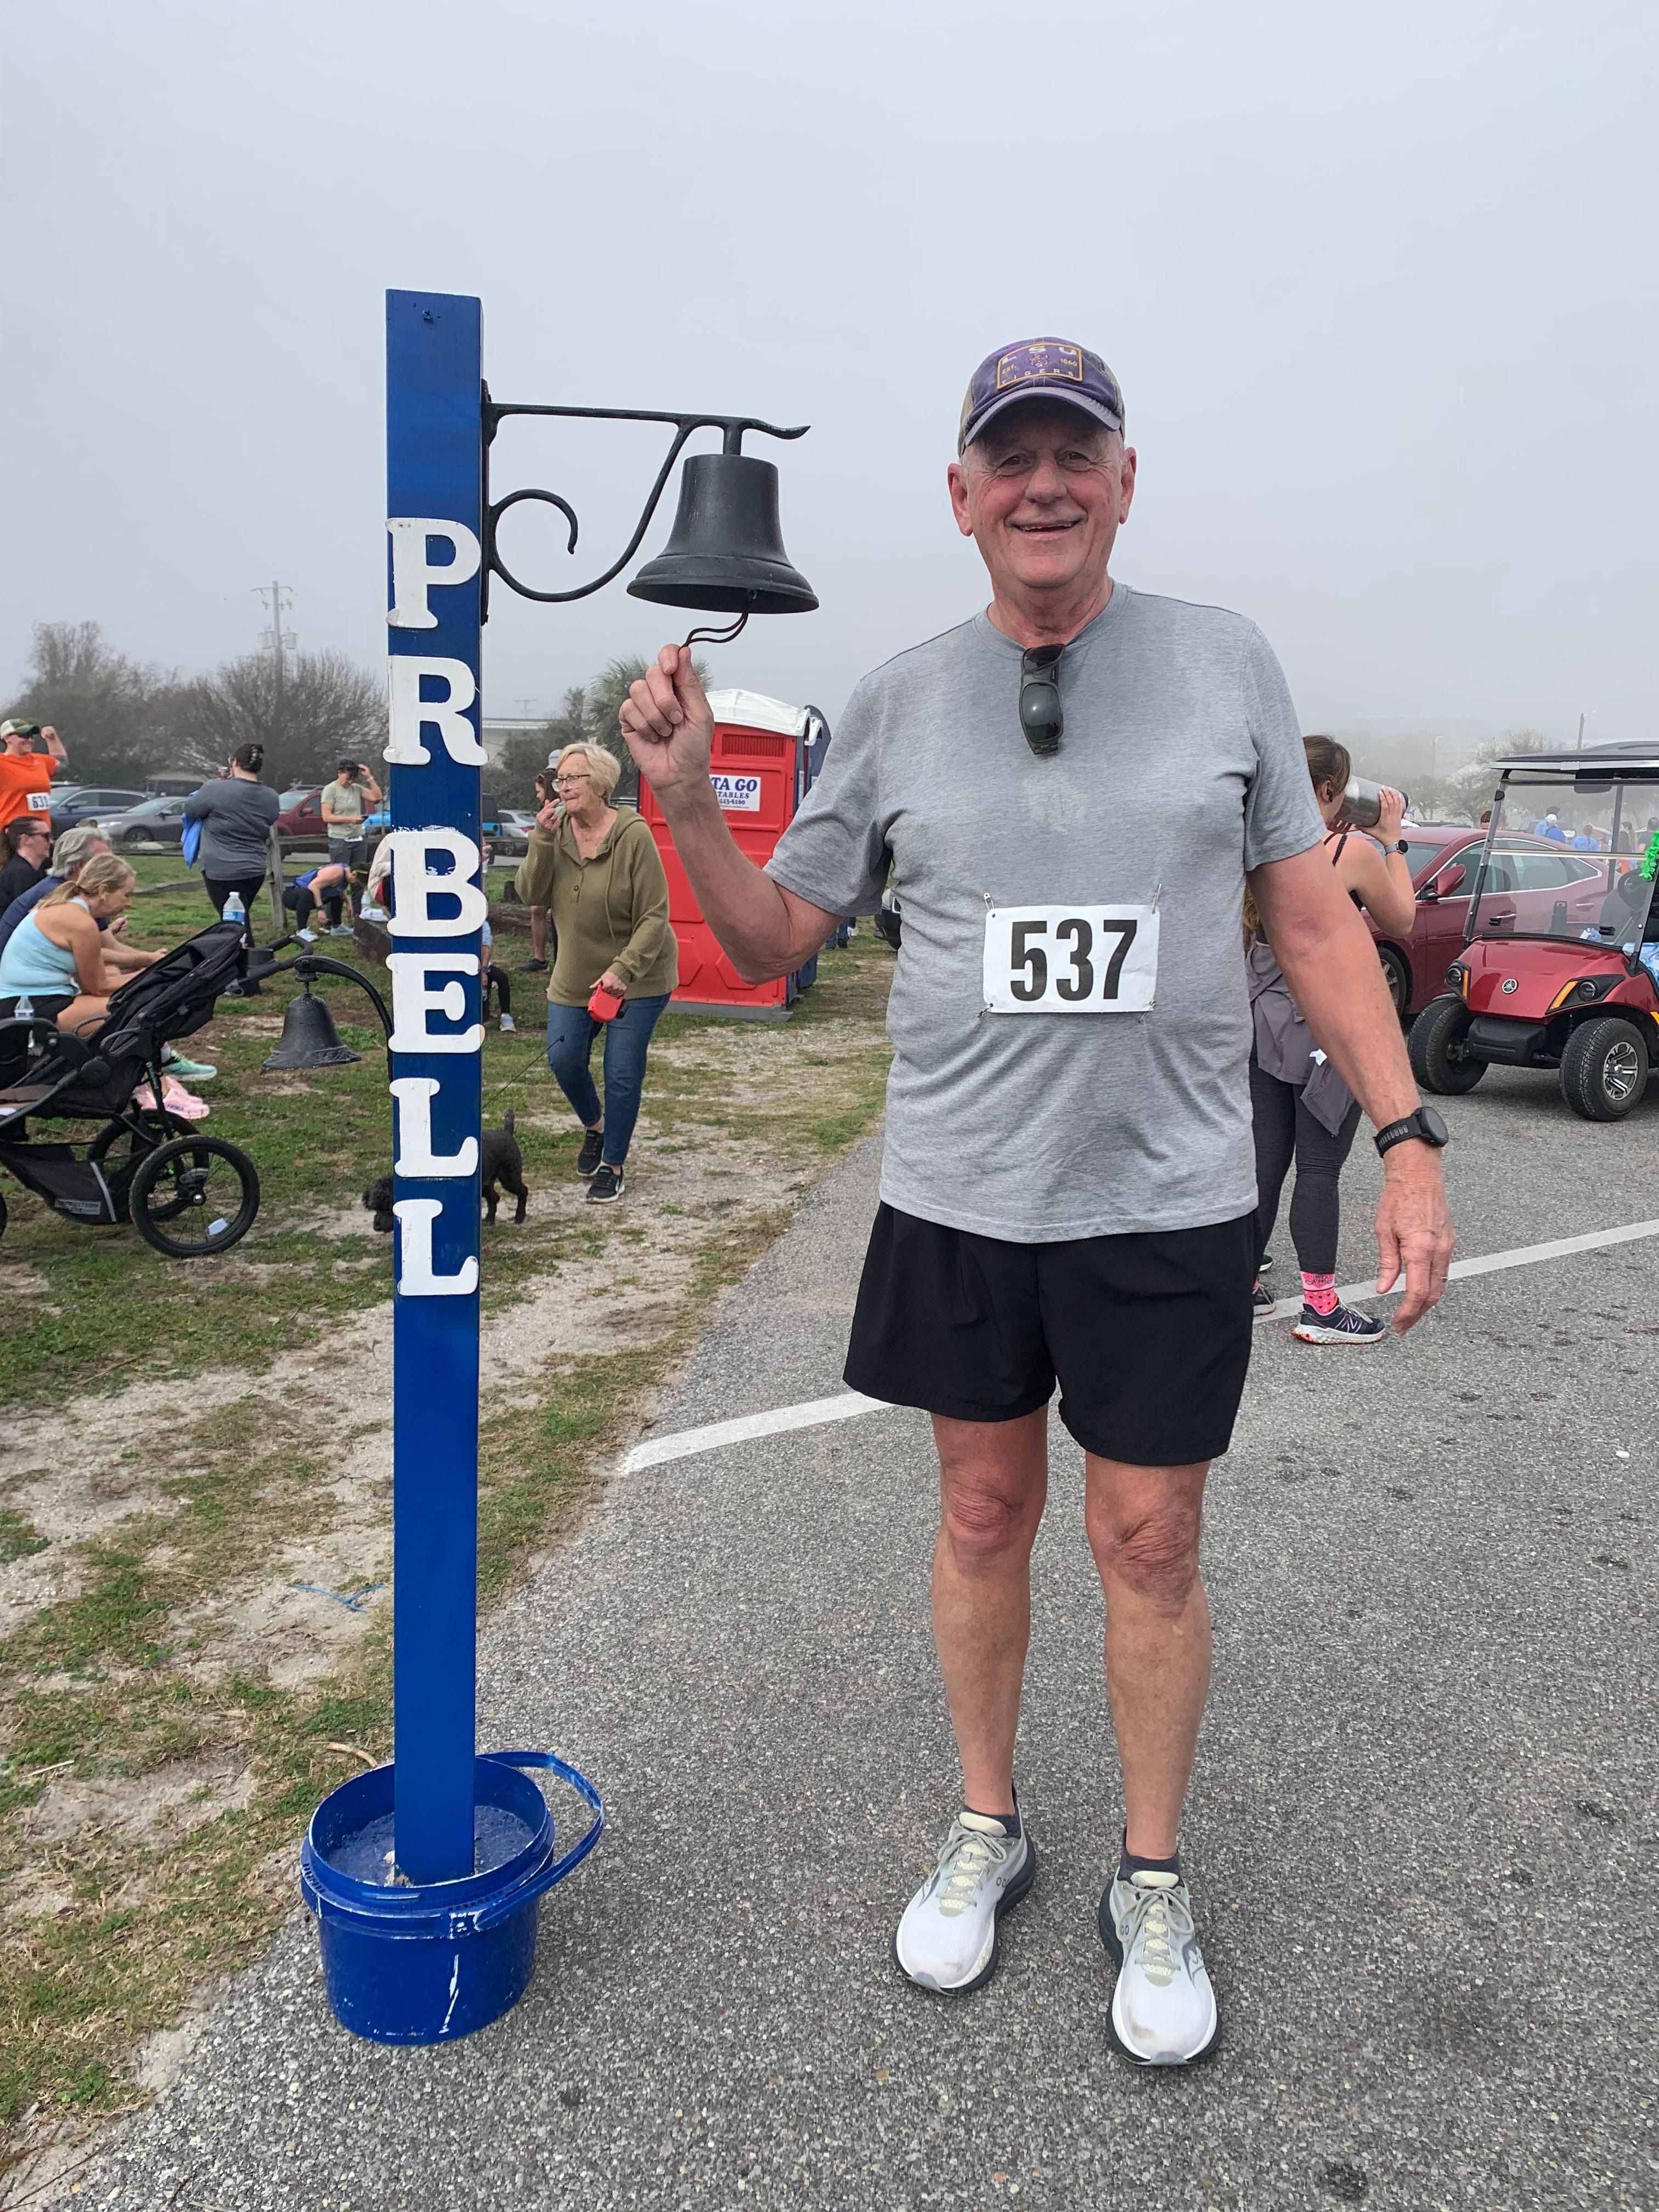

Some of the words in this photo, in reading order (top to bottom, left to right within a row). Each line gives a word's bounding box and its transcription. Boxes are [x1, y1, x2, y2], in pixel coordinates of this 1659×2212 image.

[1001, 346, 1077, 365] LSU
[1001, 368, 1074, 385] TIGERS
[735, 778, 758, 792] GO
[32, 795, 49, 808] 631
[1010, 918, 1138, 1002] 537
[385, 831, 488, 1297] BELL
